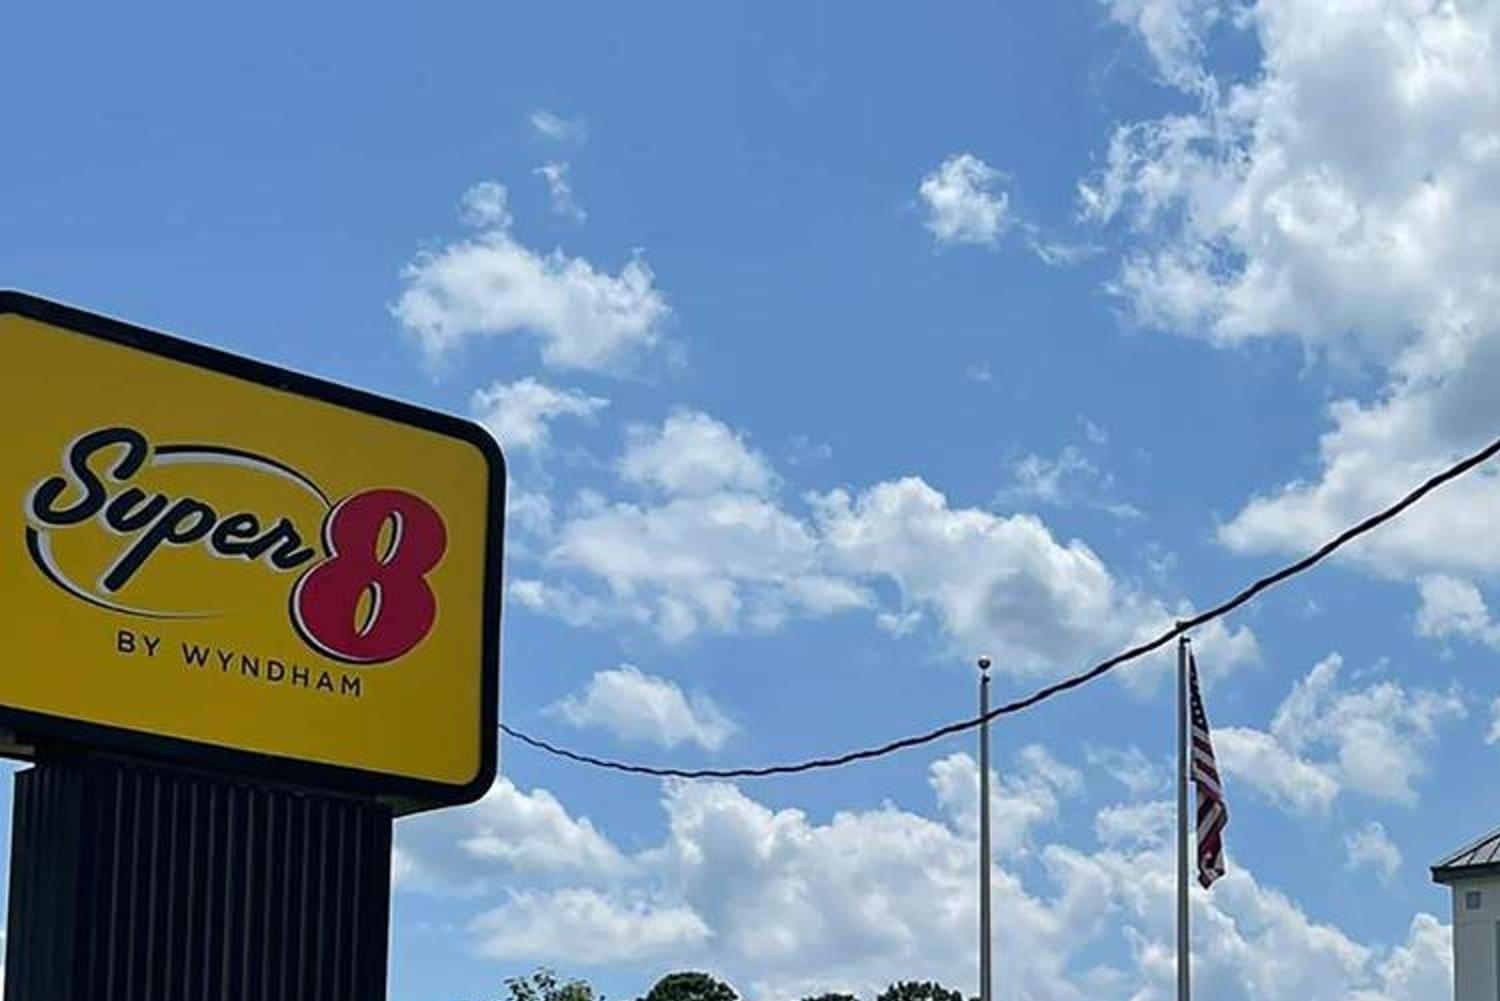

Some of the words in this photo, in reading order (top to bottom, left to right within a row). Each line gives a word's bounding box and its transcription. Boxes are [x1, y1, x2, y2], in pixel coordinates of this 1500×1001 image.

[30, 426, 316, 593] Super
[290, 487, 448, 664] 8
[116, 629, 161, 658] BY
[182, 643, 362, 697] WYNDHAM
